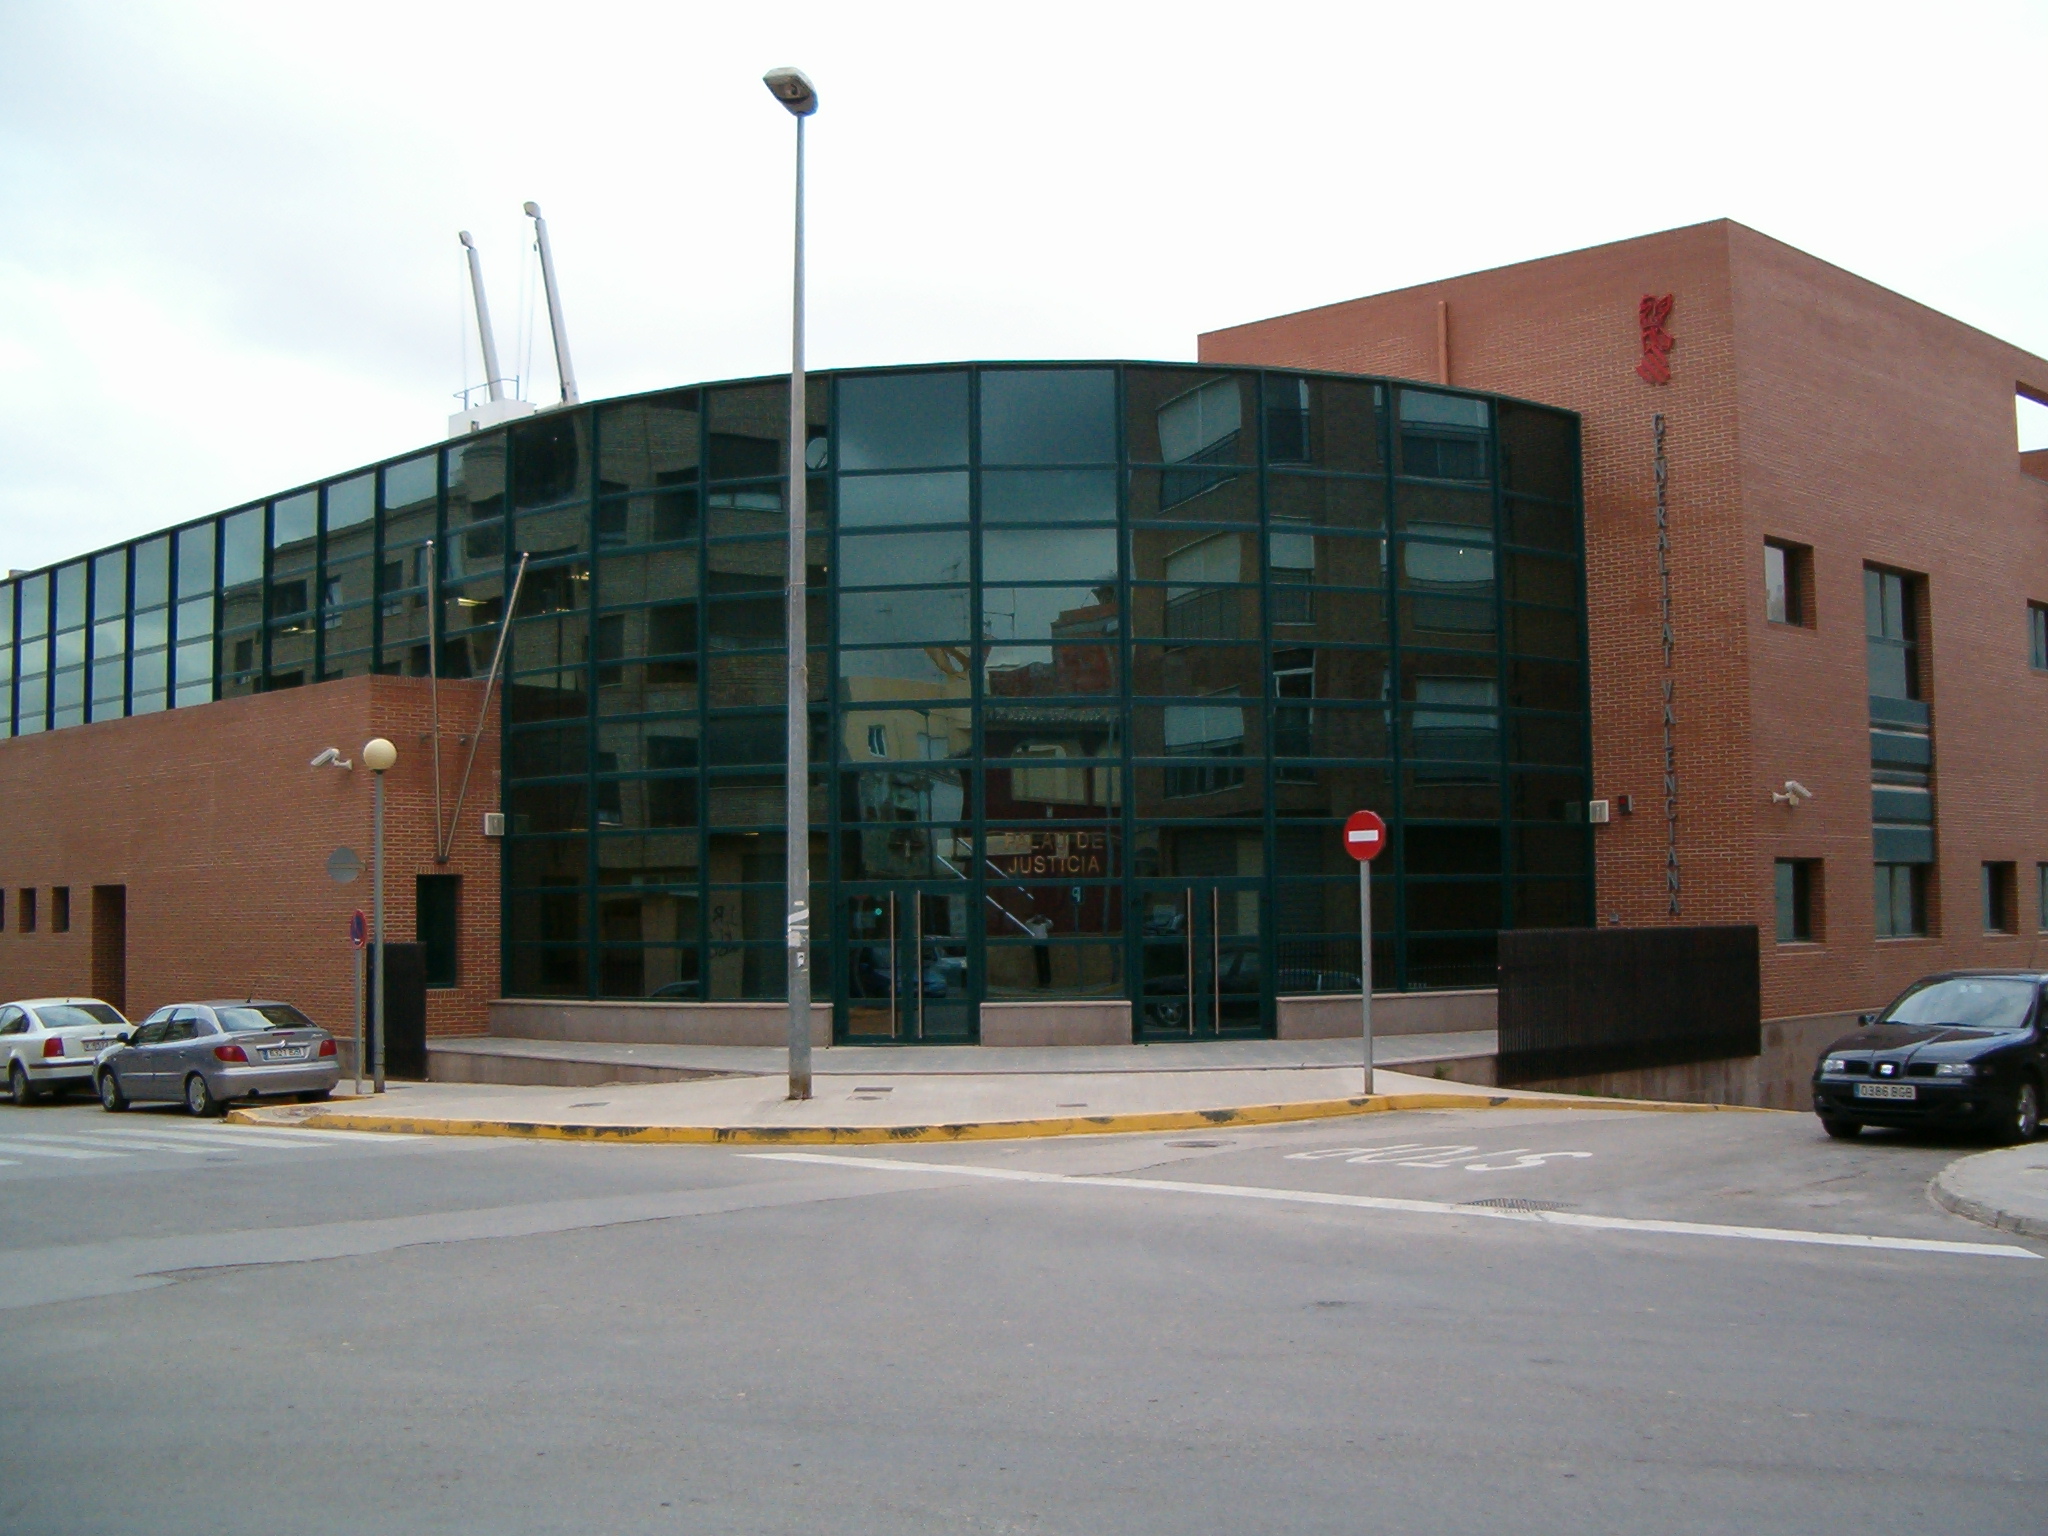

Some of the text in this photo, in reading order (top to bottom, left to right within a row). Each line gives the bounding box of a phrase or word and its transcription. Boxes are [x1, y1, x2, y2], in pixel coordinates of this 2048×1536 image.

[1652, 413, 1681, 916] GENERALITAT VALENCIANA
[1077, 831, 1104, 849] DE
[1008, 855, 1100, 874] JUSTICIA
